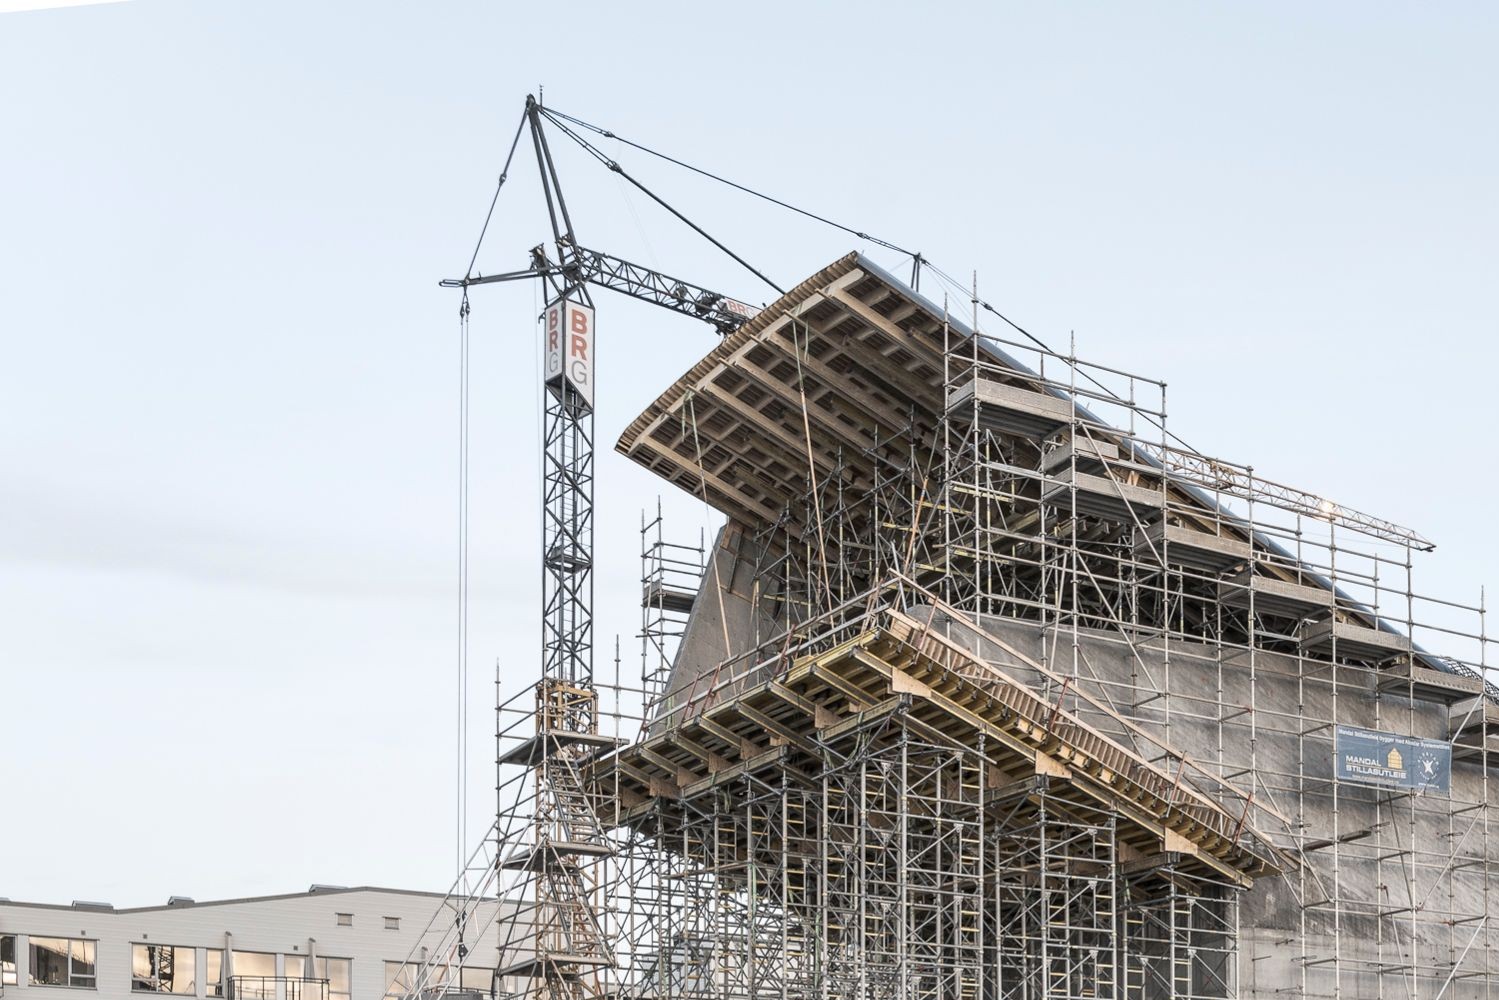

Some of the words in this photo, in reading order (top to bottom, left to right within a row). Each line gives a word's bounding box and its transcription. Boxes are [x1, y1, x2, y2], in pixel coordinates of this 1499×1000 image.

[550, 309, 558, 373] BRG
[571, 309, 587, 385] BRG
[1346, 755, 1381, 767] MANDAL
[1346, 764, 1407, 779] STILLASUTLEIE
